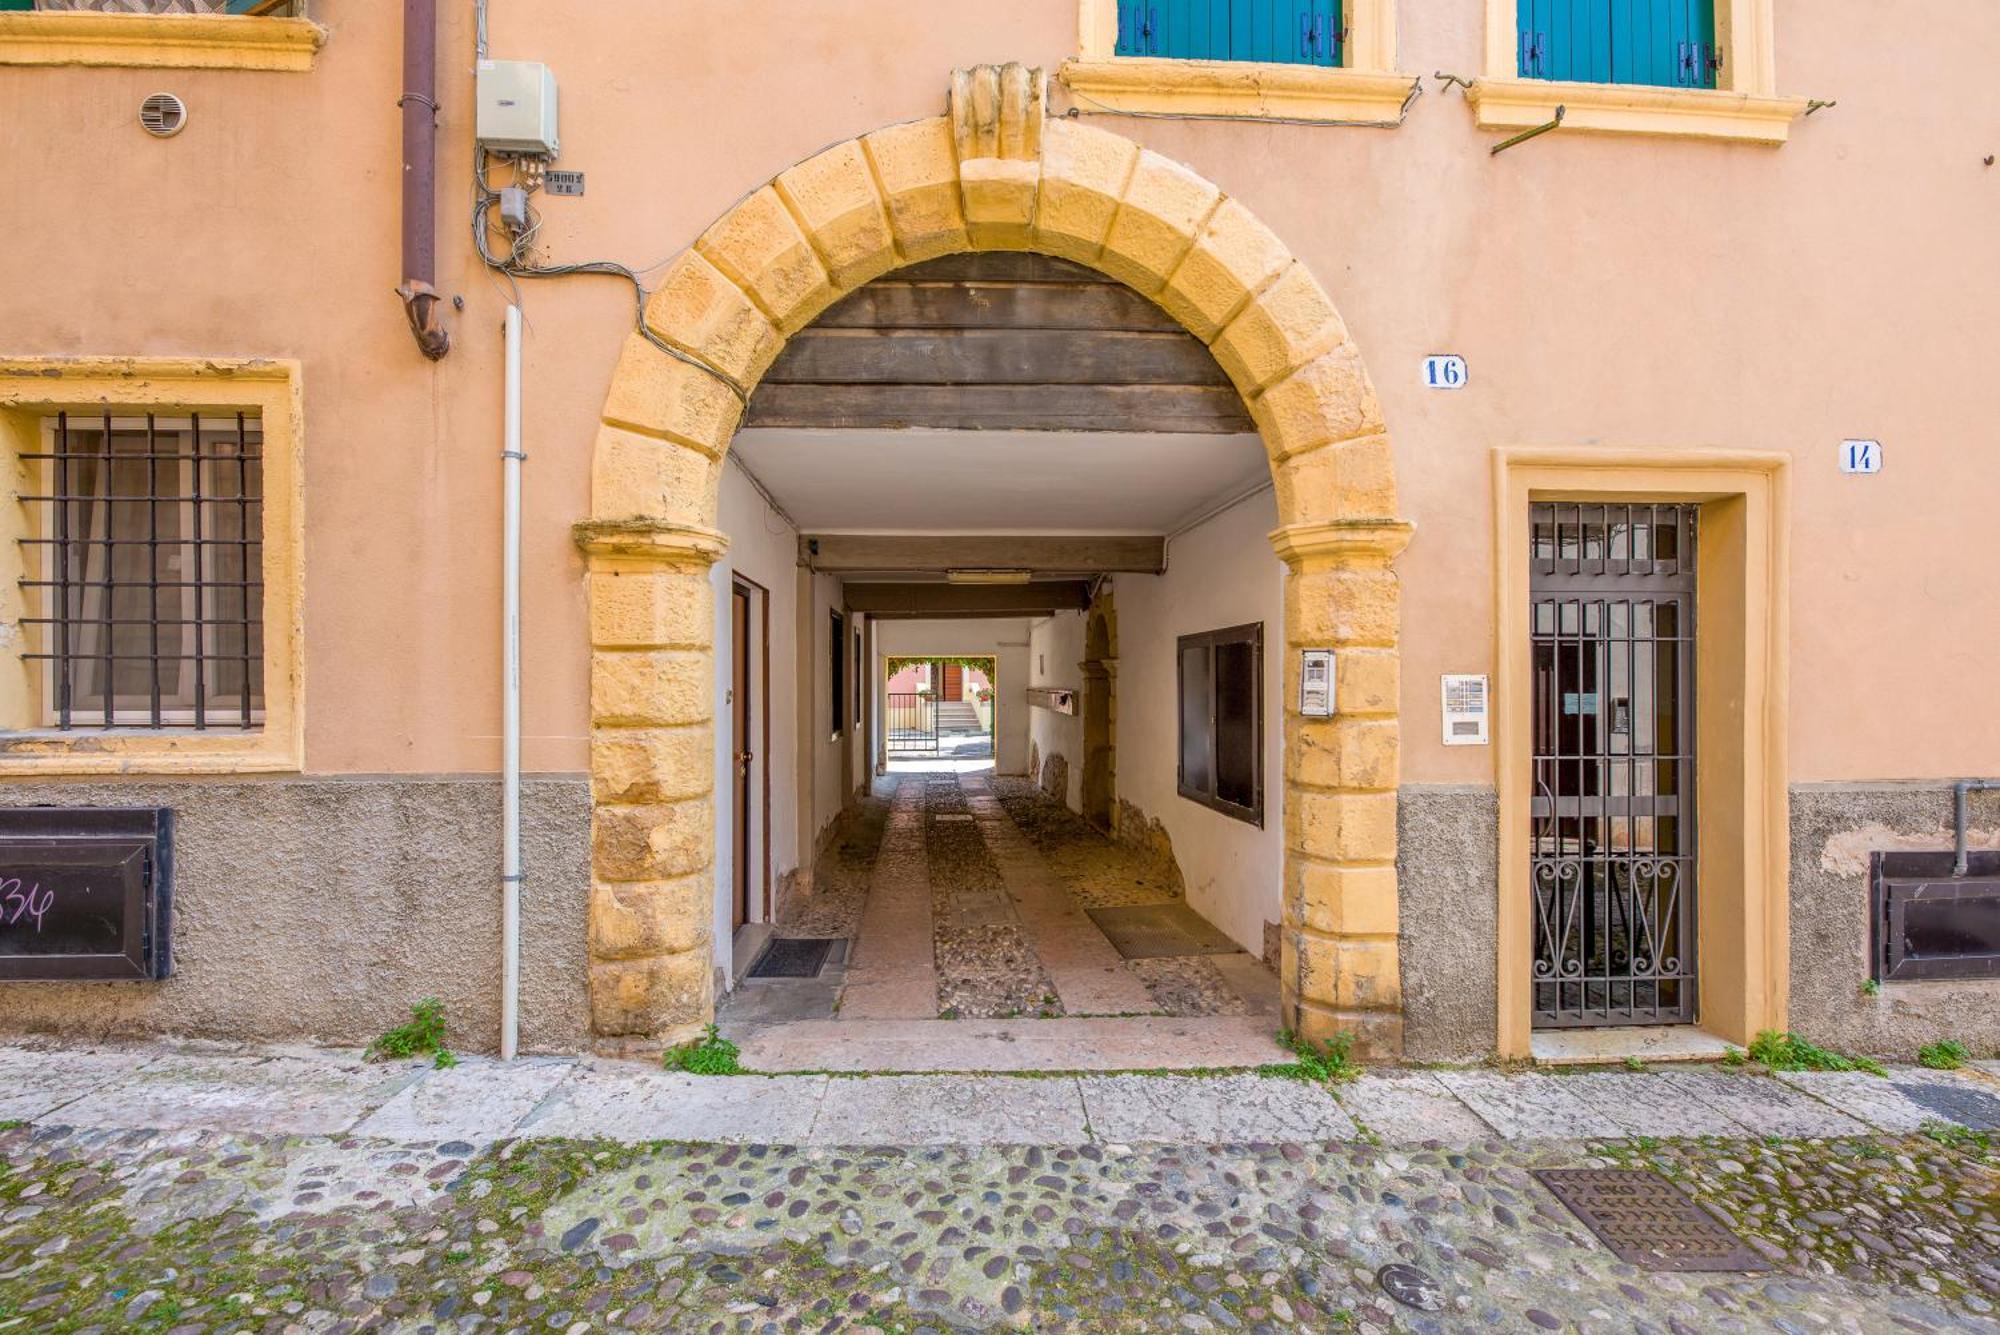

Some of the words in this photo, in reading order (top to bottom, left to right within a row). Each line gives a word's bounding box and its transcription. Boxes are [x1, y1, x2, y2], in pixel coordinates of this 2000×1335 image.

[1427, 360, 1459, 385] 16
[1850, 444, 1870, 469] 14
[0, 877, 55, 932] 34
